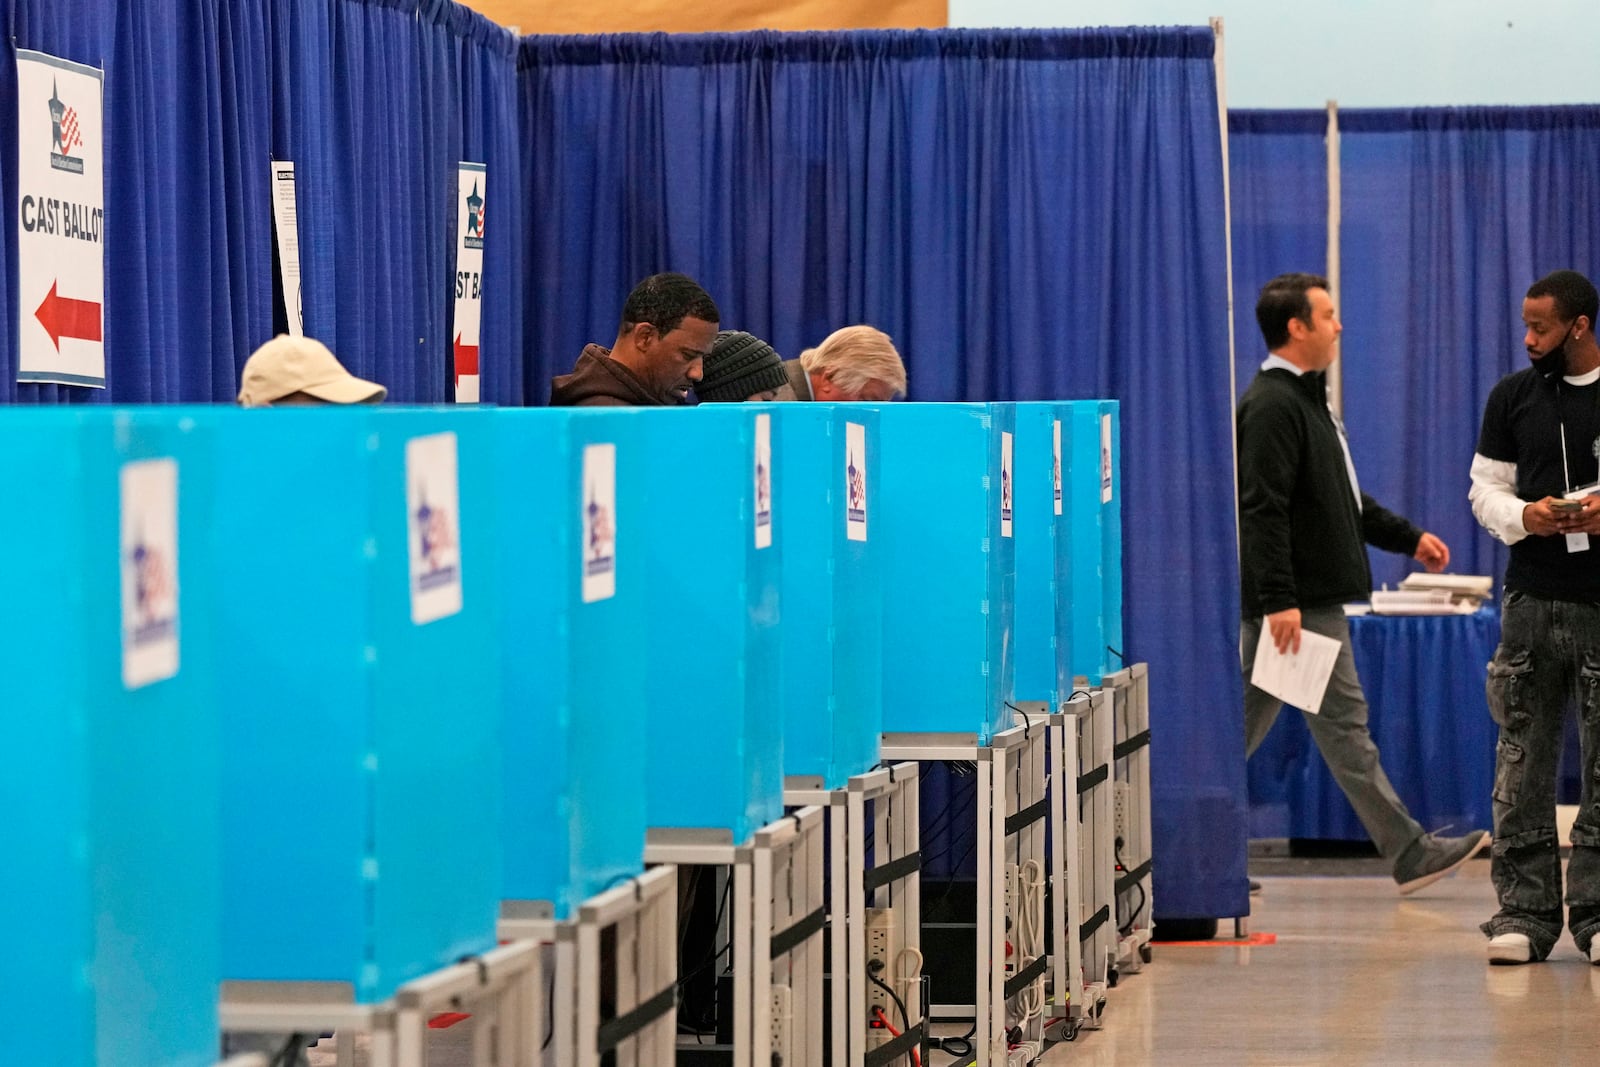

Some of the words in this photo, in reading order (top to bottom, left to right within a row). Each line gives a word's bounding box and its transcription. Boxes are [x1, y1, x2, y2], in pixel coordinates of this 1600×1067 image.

[21, 194, 60, 236] CAST
[63, 201, 103, 244] BALLOT
[455, 271, 470, 299] ST
